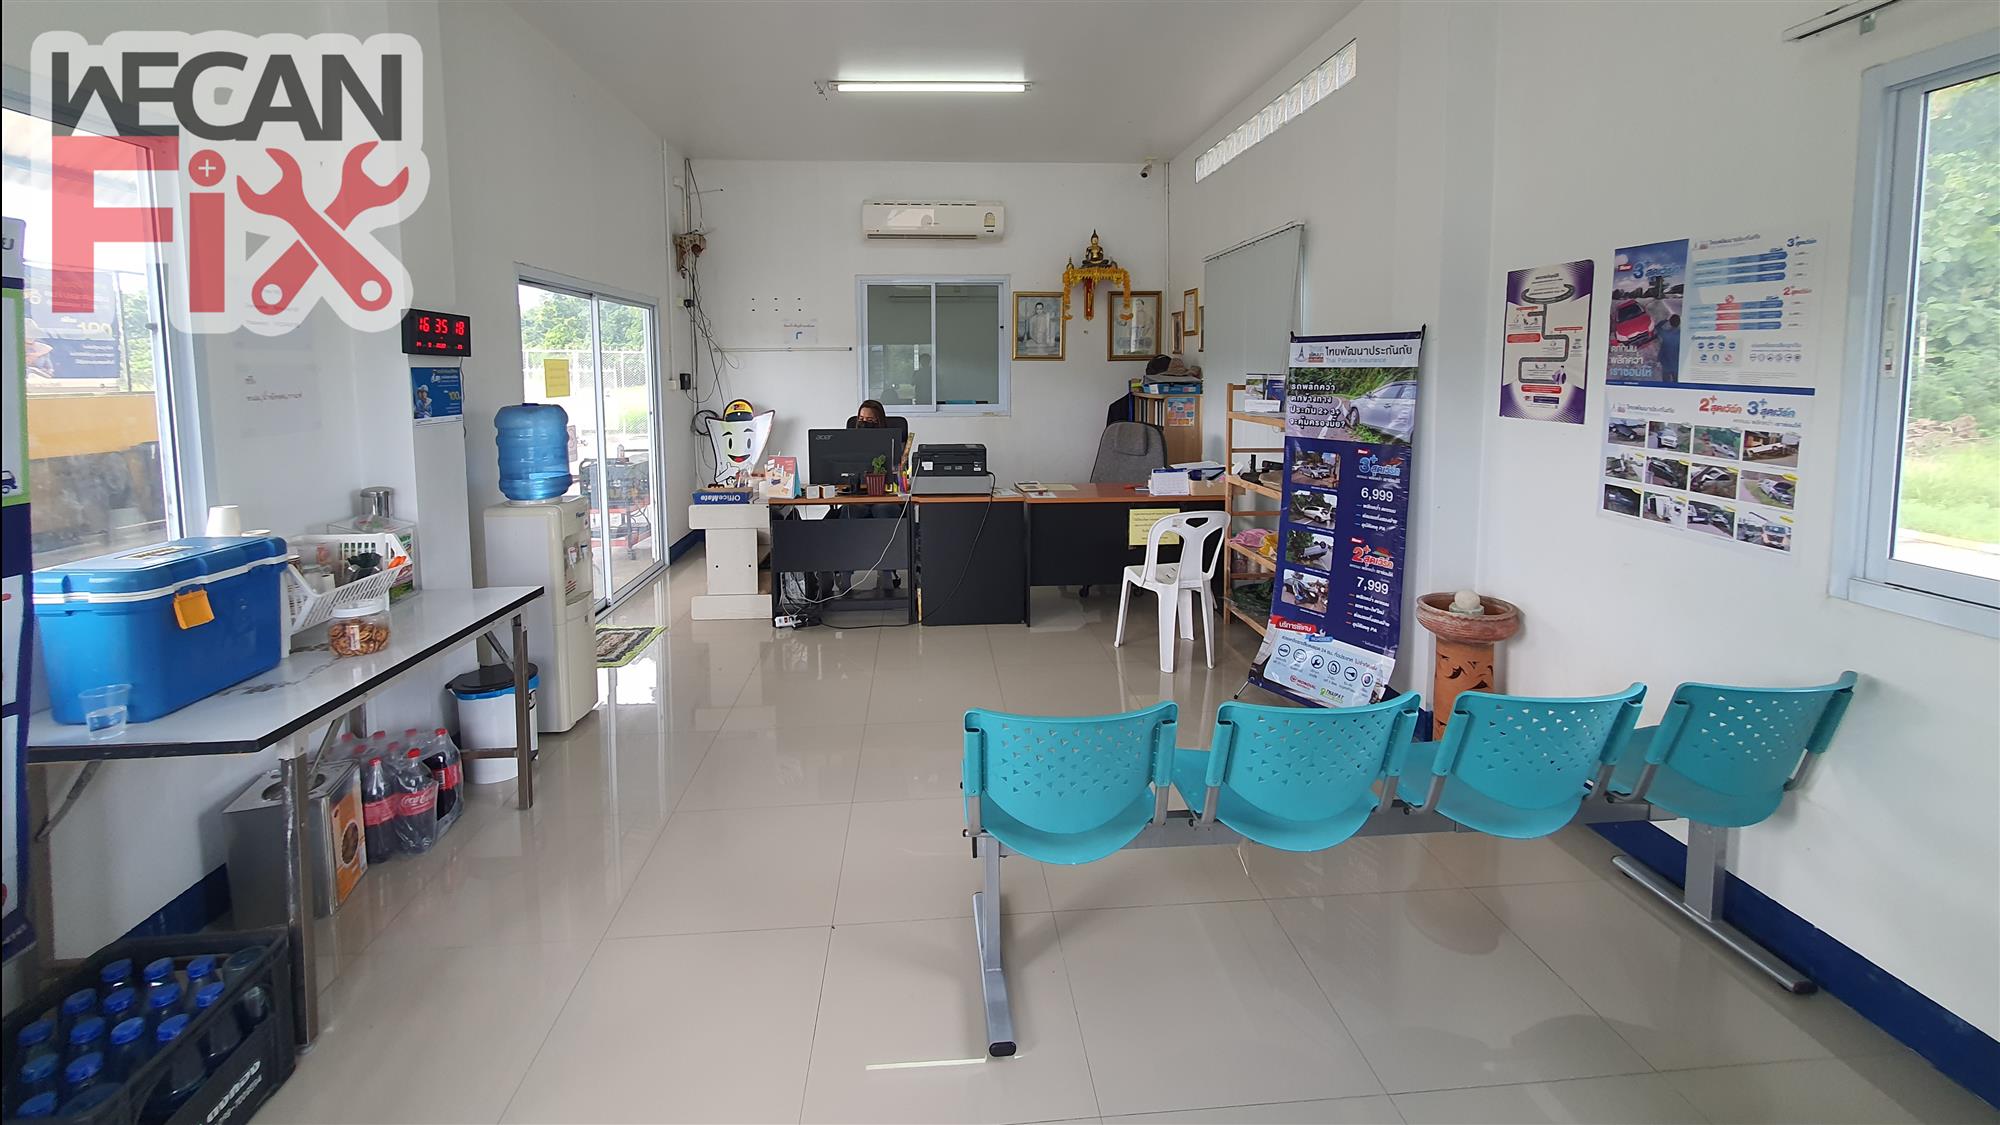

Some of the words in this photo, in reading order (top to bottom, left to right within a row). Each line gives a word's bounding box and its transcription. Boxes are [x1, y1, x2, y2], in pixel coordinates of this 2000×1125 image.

[419, 316, 430, 332] 16
[434, 318, 448, 334] 35
[455, 321, 465, 336] 18
[1361, 487, 1394, 502] 6,999
[1357, 576, 1389, 595] 7,999
